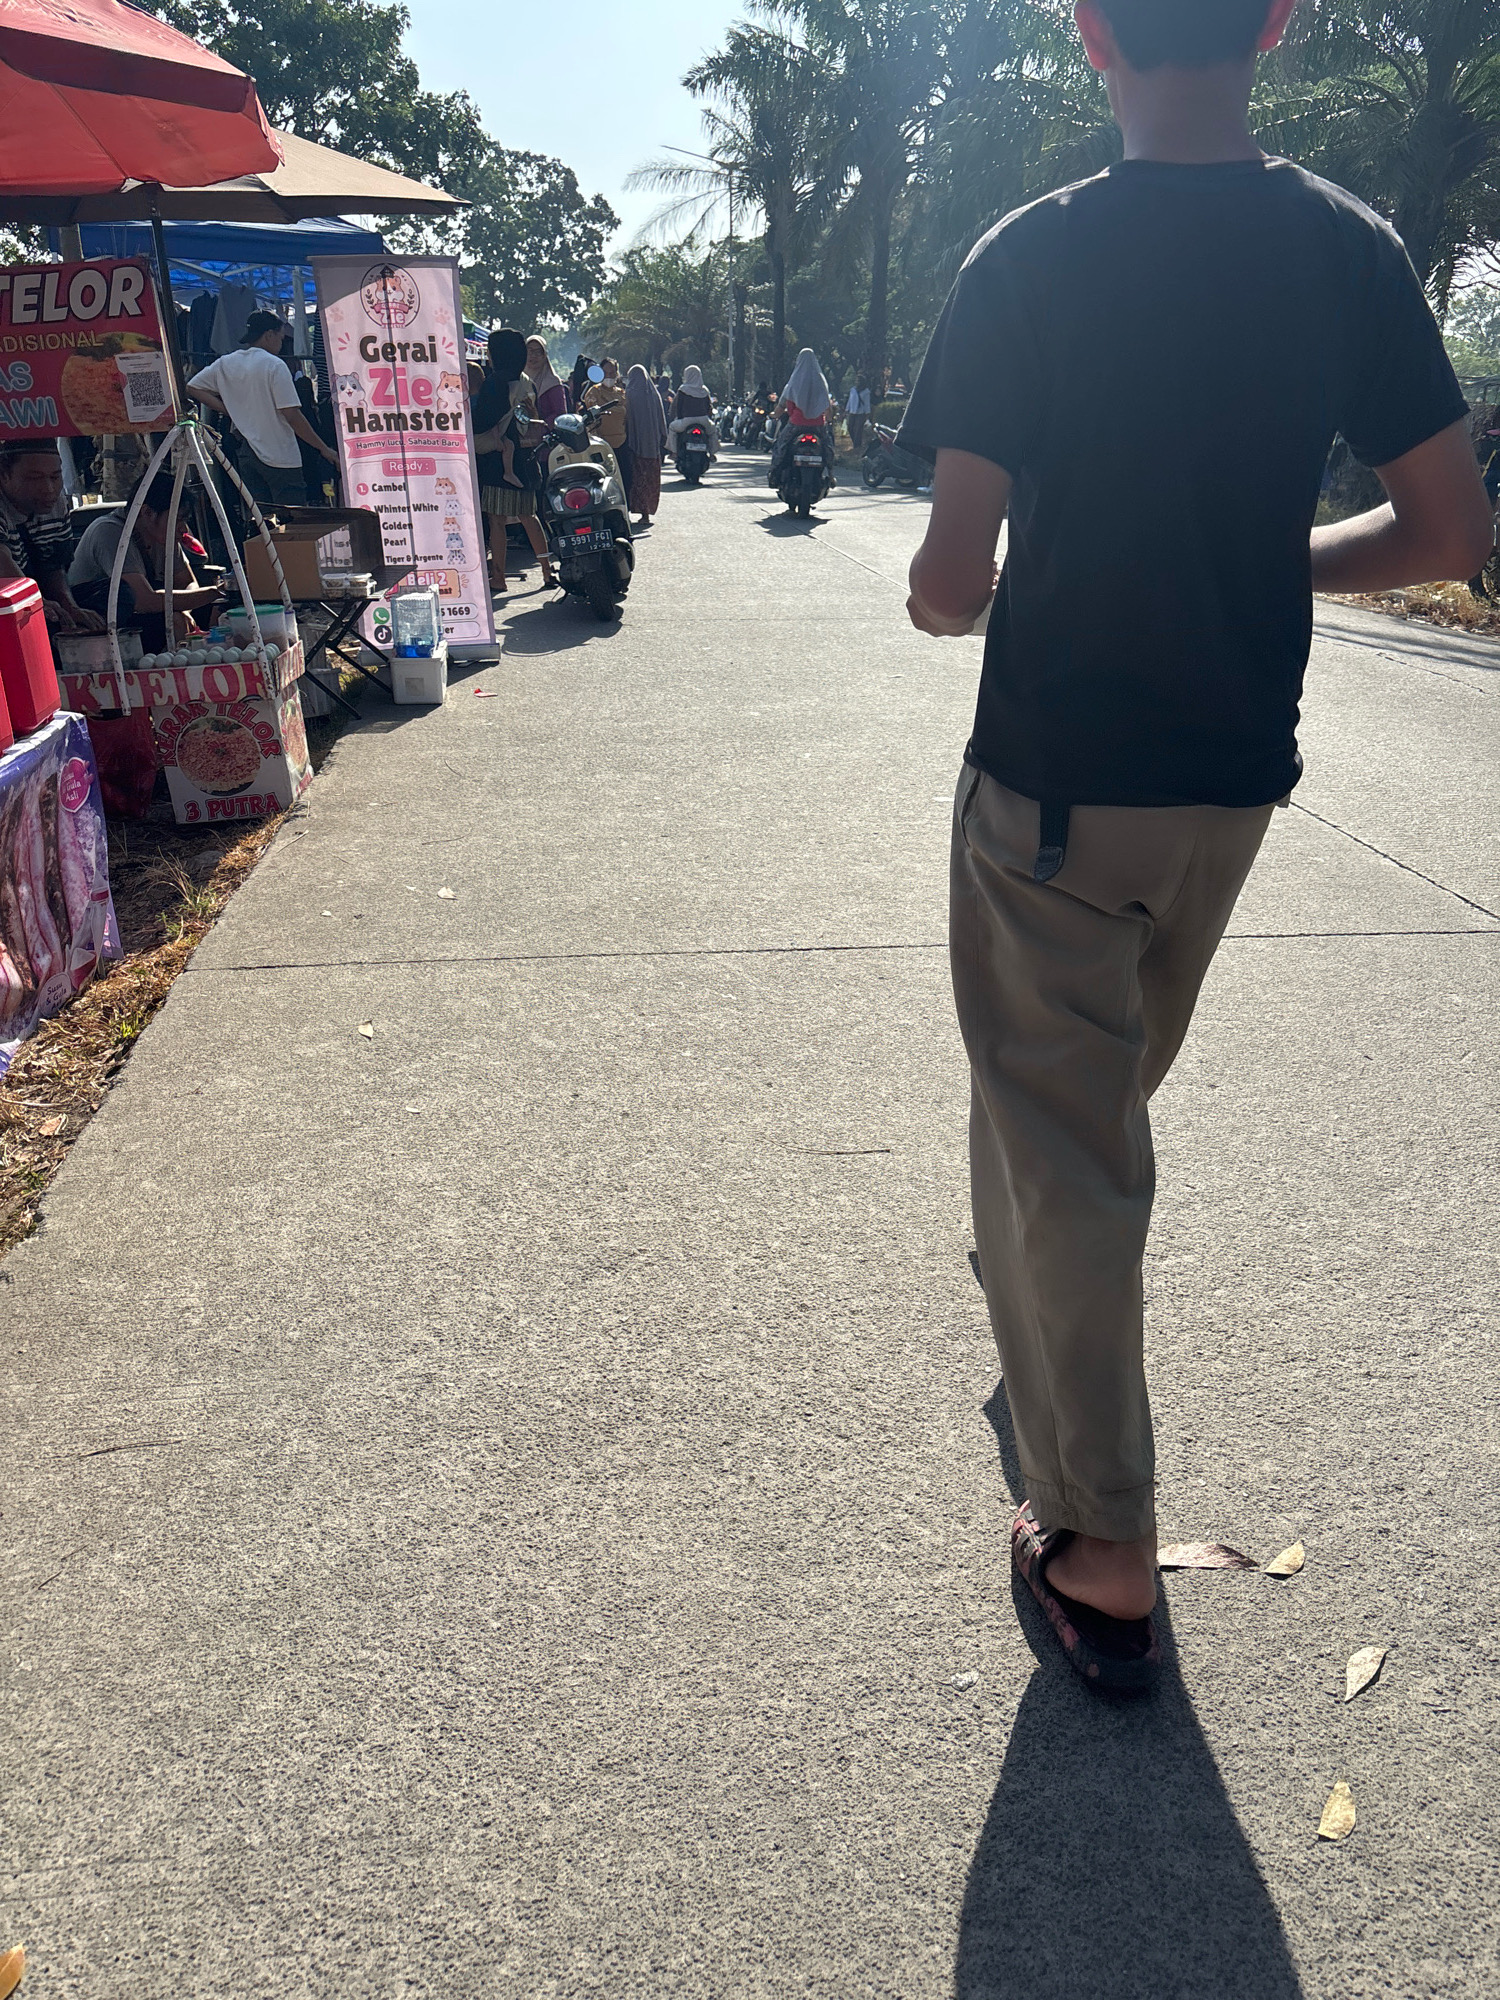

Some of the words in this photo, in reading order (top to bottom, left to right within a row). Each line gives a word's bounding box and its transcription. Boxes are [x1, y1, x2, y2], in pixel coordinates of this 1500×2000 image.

[360, 336, 438, 363] Gerai
[368, 368, 433, 406] Zie
[345, 408, 463, 434] Hamster
[356, 441, 385, 450] Hammy
[408, 438, 440, 446] Sahabat
[441, 439, 460, 447] Baru
[389, 462, 423, 472] Ready
[371, 482, 407, 493] Cambel
[374, 505, 411, 514] Whinter
[412, 503, 439, 512] White
[382, 522, 414, 531] Golden
[384, 538, 407, 547] Pearl
[385, 556, 405, 564] Tiger
[413, 554, 444, 563] Argente
[407, 572, 435, 586] Beli
[437, 572, 448, 586] 2
[446, 606, 471, 616] 1669
[158, 700, 210, 766] KERAK
[214, 700, 283, 759] TELOR
[185, 802, 202, 822] 3
[207, 791, 283, 820] PUTRA
